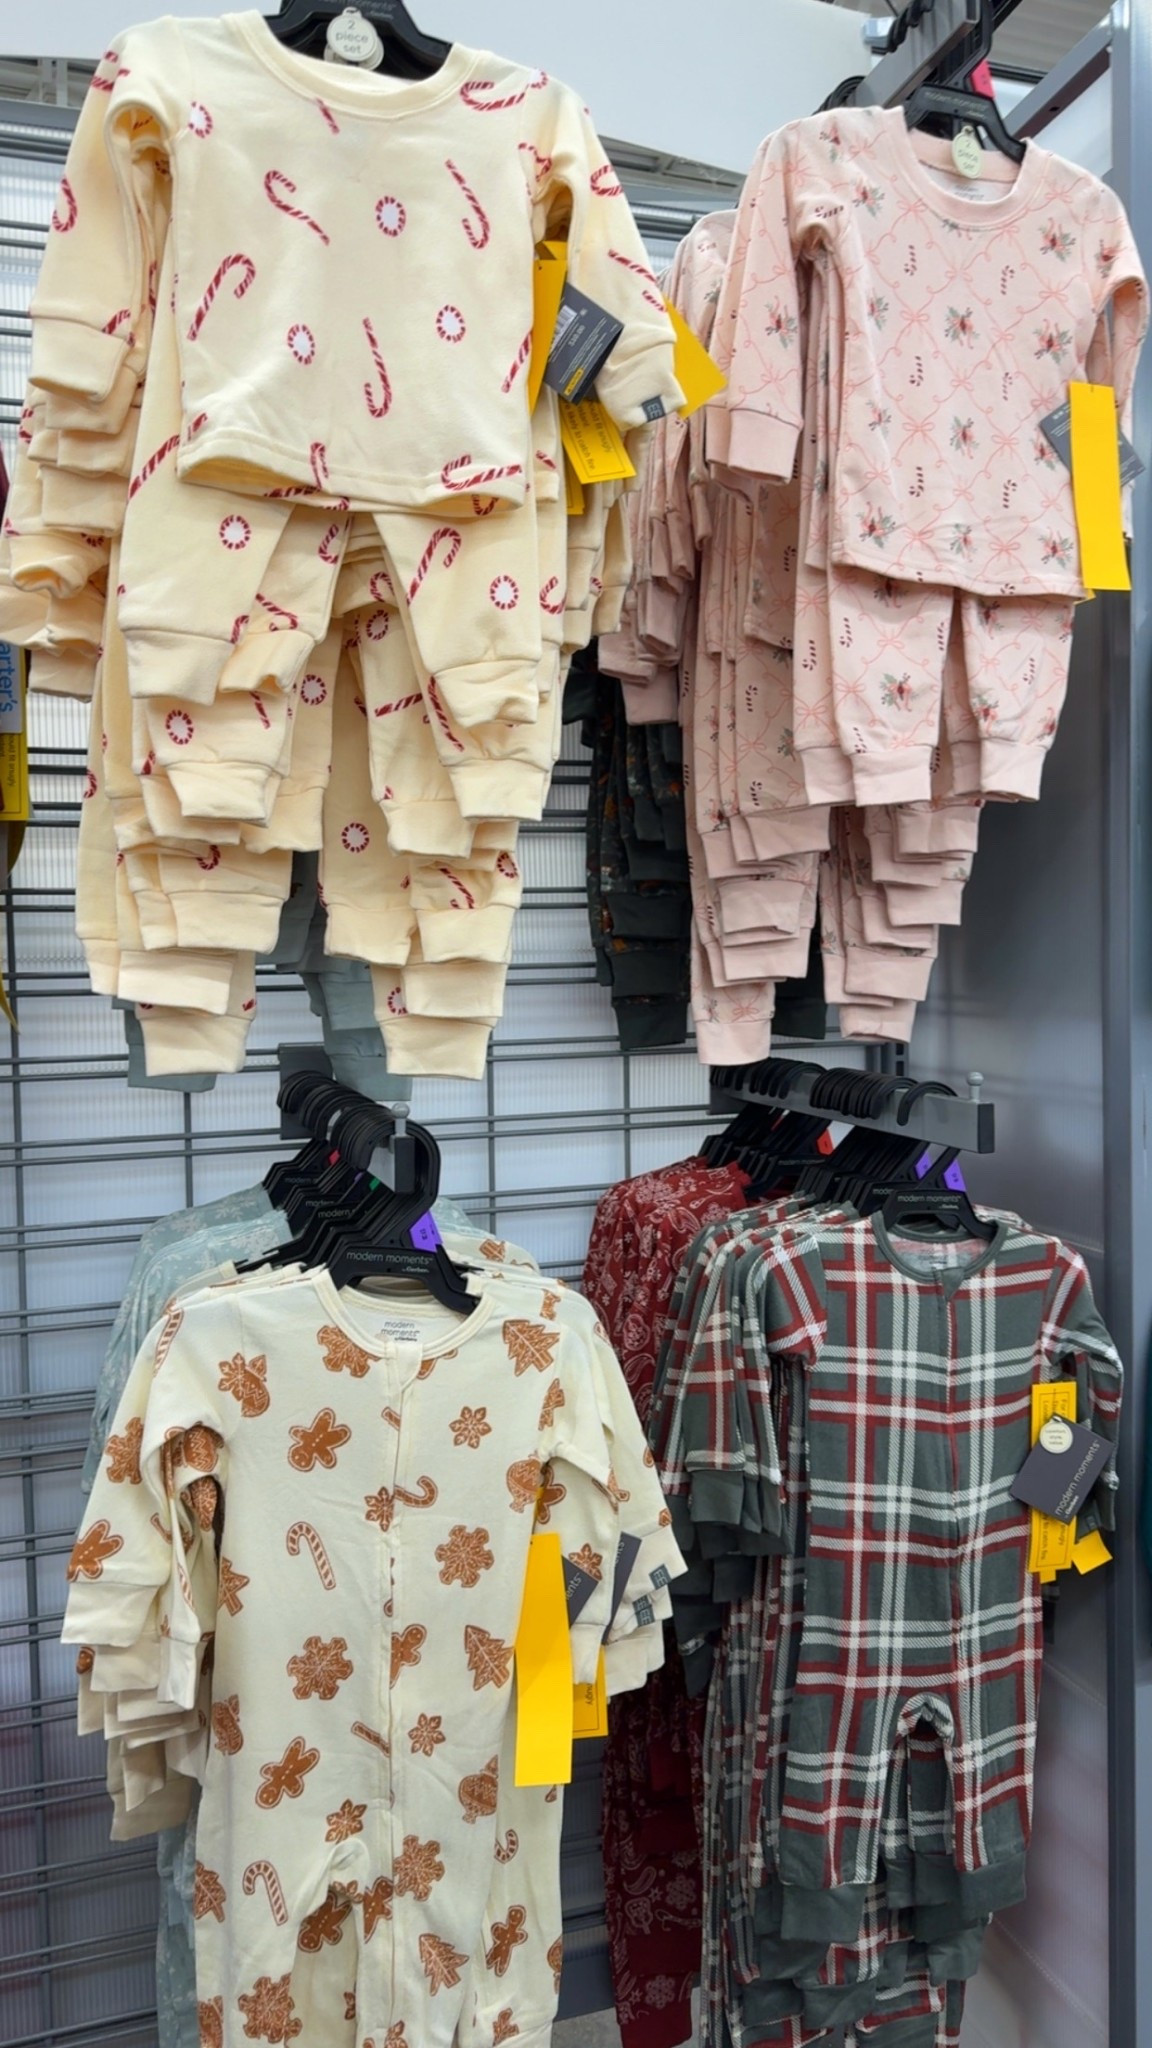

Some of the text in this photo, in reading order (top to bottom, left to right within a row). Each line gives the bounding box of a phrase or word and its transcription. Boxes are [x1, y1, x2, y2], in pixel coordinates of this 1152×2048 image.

[348, 21, 356, 31] 2
[335, 32, 368, 42] piece
[343, 44, 362, 54] set
[0, 640, 17, 712] arter's
[897, 1194, 925, 1202] modern
[347, 1252, 430, 1265] modern moments
[384, 1321, 415, 1329] modern
[381, 1329, 418, 1338] moments
[1055, 1442, 1100, 1515] modern moments
[566, 1574, 581, 1598] ents
